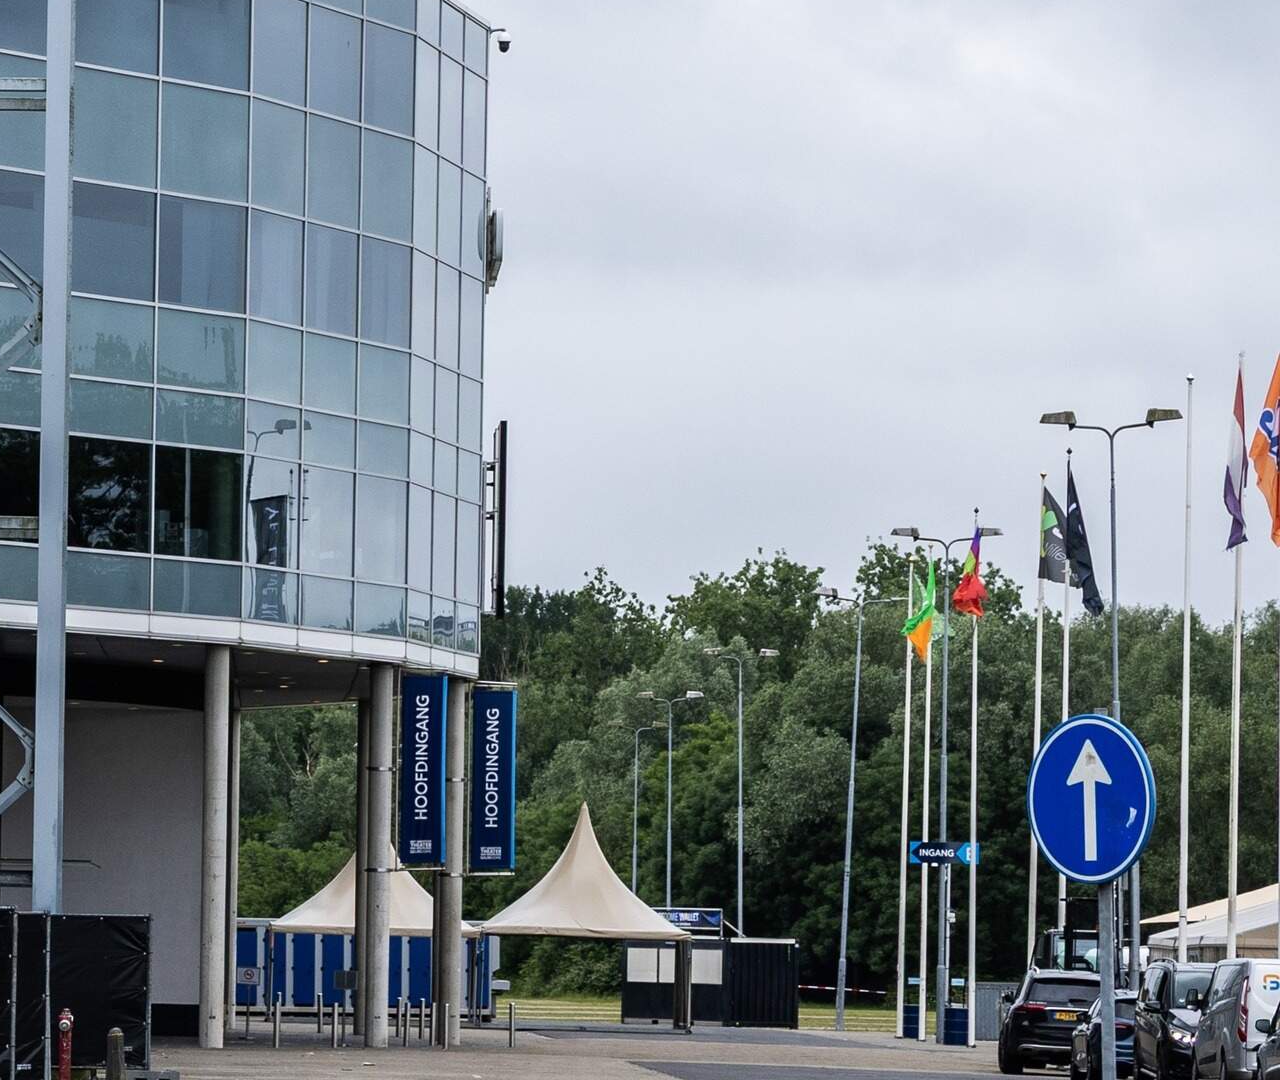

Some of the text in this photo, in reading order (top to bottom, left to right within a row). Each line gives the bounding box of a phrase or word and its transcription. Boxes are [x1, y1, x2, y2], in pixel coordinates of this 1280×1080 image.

[414, 694, 431, 820] HOOFDINGANG
[484, 708, 500, 828] HOOFDINGANG
[919, 849, 954, 858] INGANG
